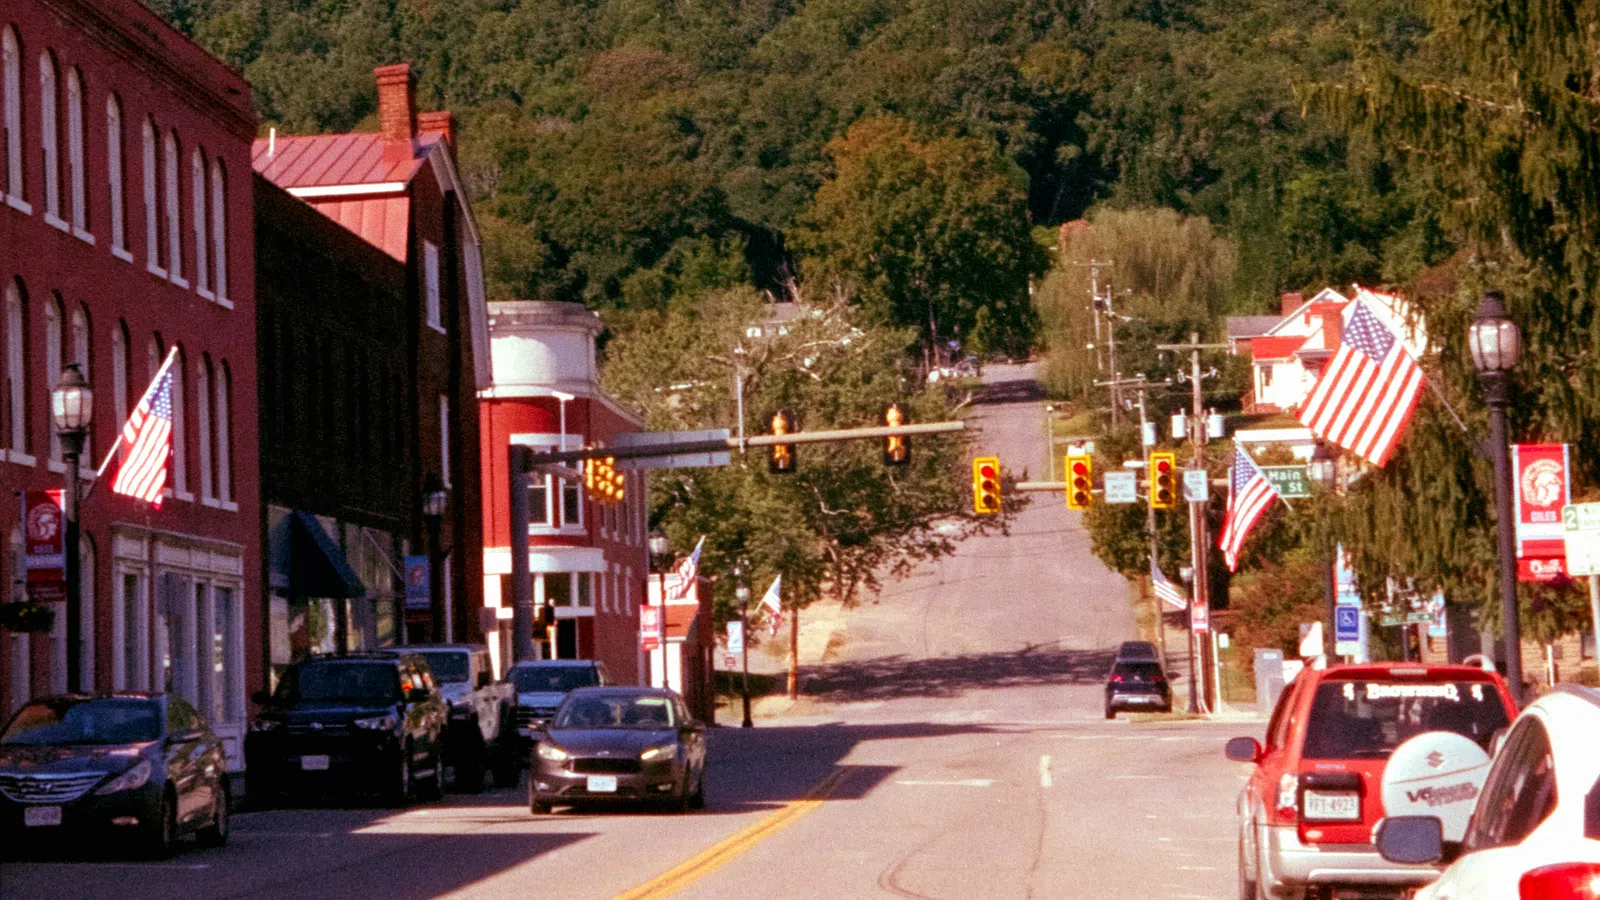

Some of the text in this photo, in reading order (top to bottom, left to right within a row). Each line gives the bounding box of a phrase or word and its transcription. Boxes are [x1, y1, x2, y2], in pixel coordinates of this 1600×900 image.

[1268, 470, 1301, 481] Main
[1289, 482, 1303, 492] St
[1565, 510, 1577, 528] 2
